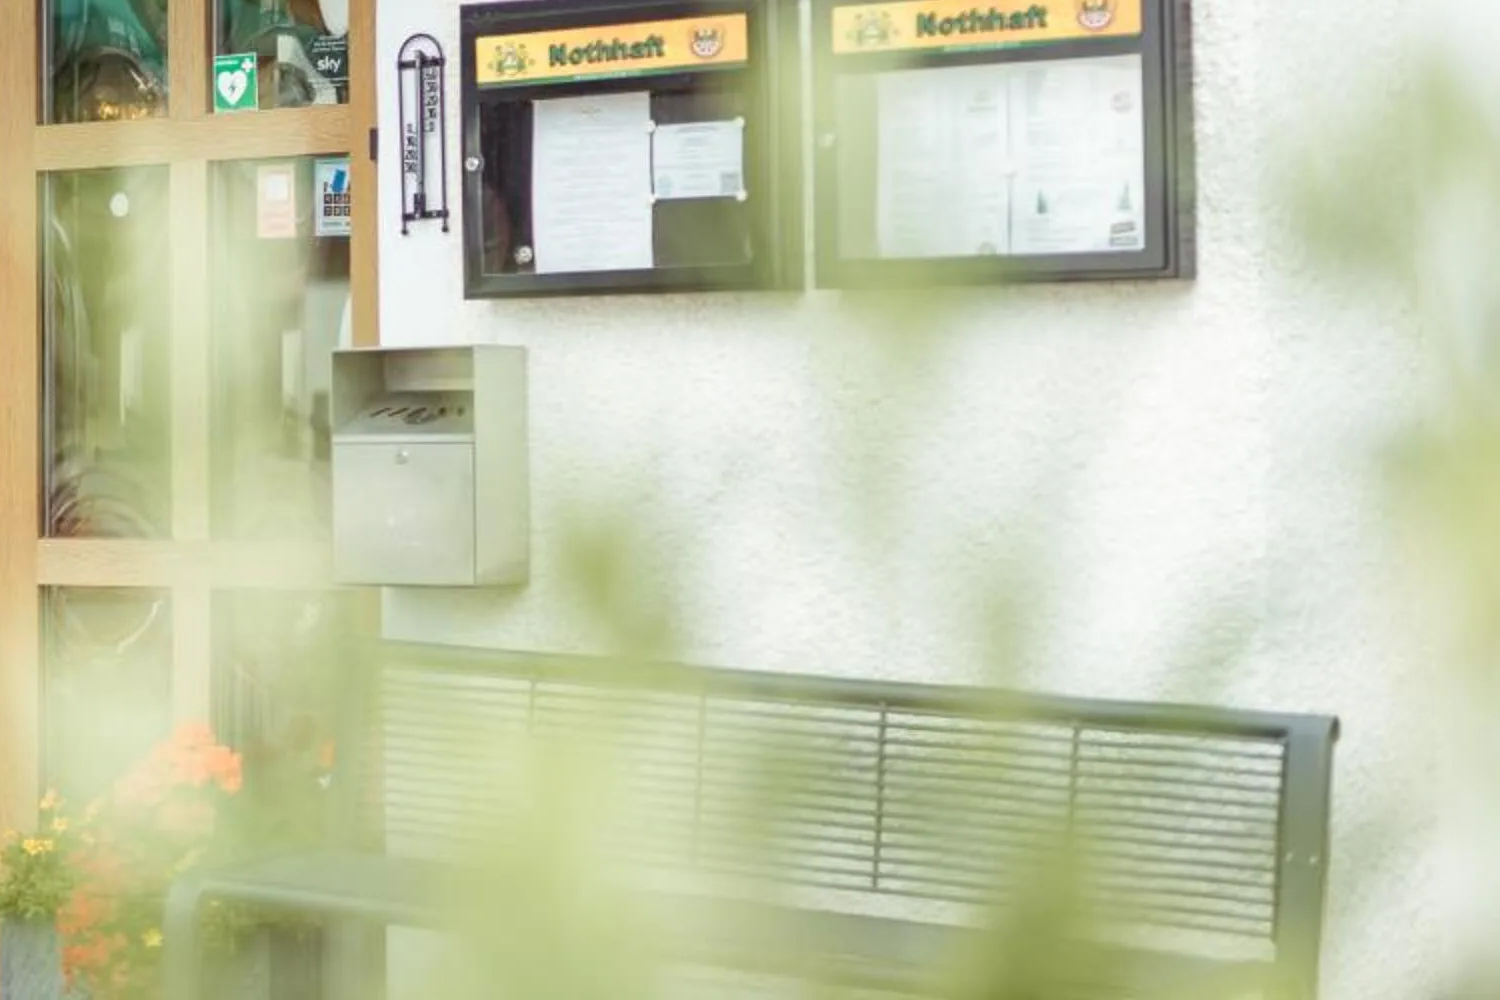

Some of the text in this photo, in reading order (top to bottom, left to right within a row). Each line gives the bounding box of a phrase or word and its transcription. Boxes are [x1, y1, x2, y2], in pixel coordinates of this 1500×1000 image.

[916, 3, 1048, 38] Nothhaft
[317, 55, 341, 73] sky
[548, 33, 665, 67] Nothhaft
